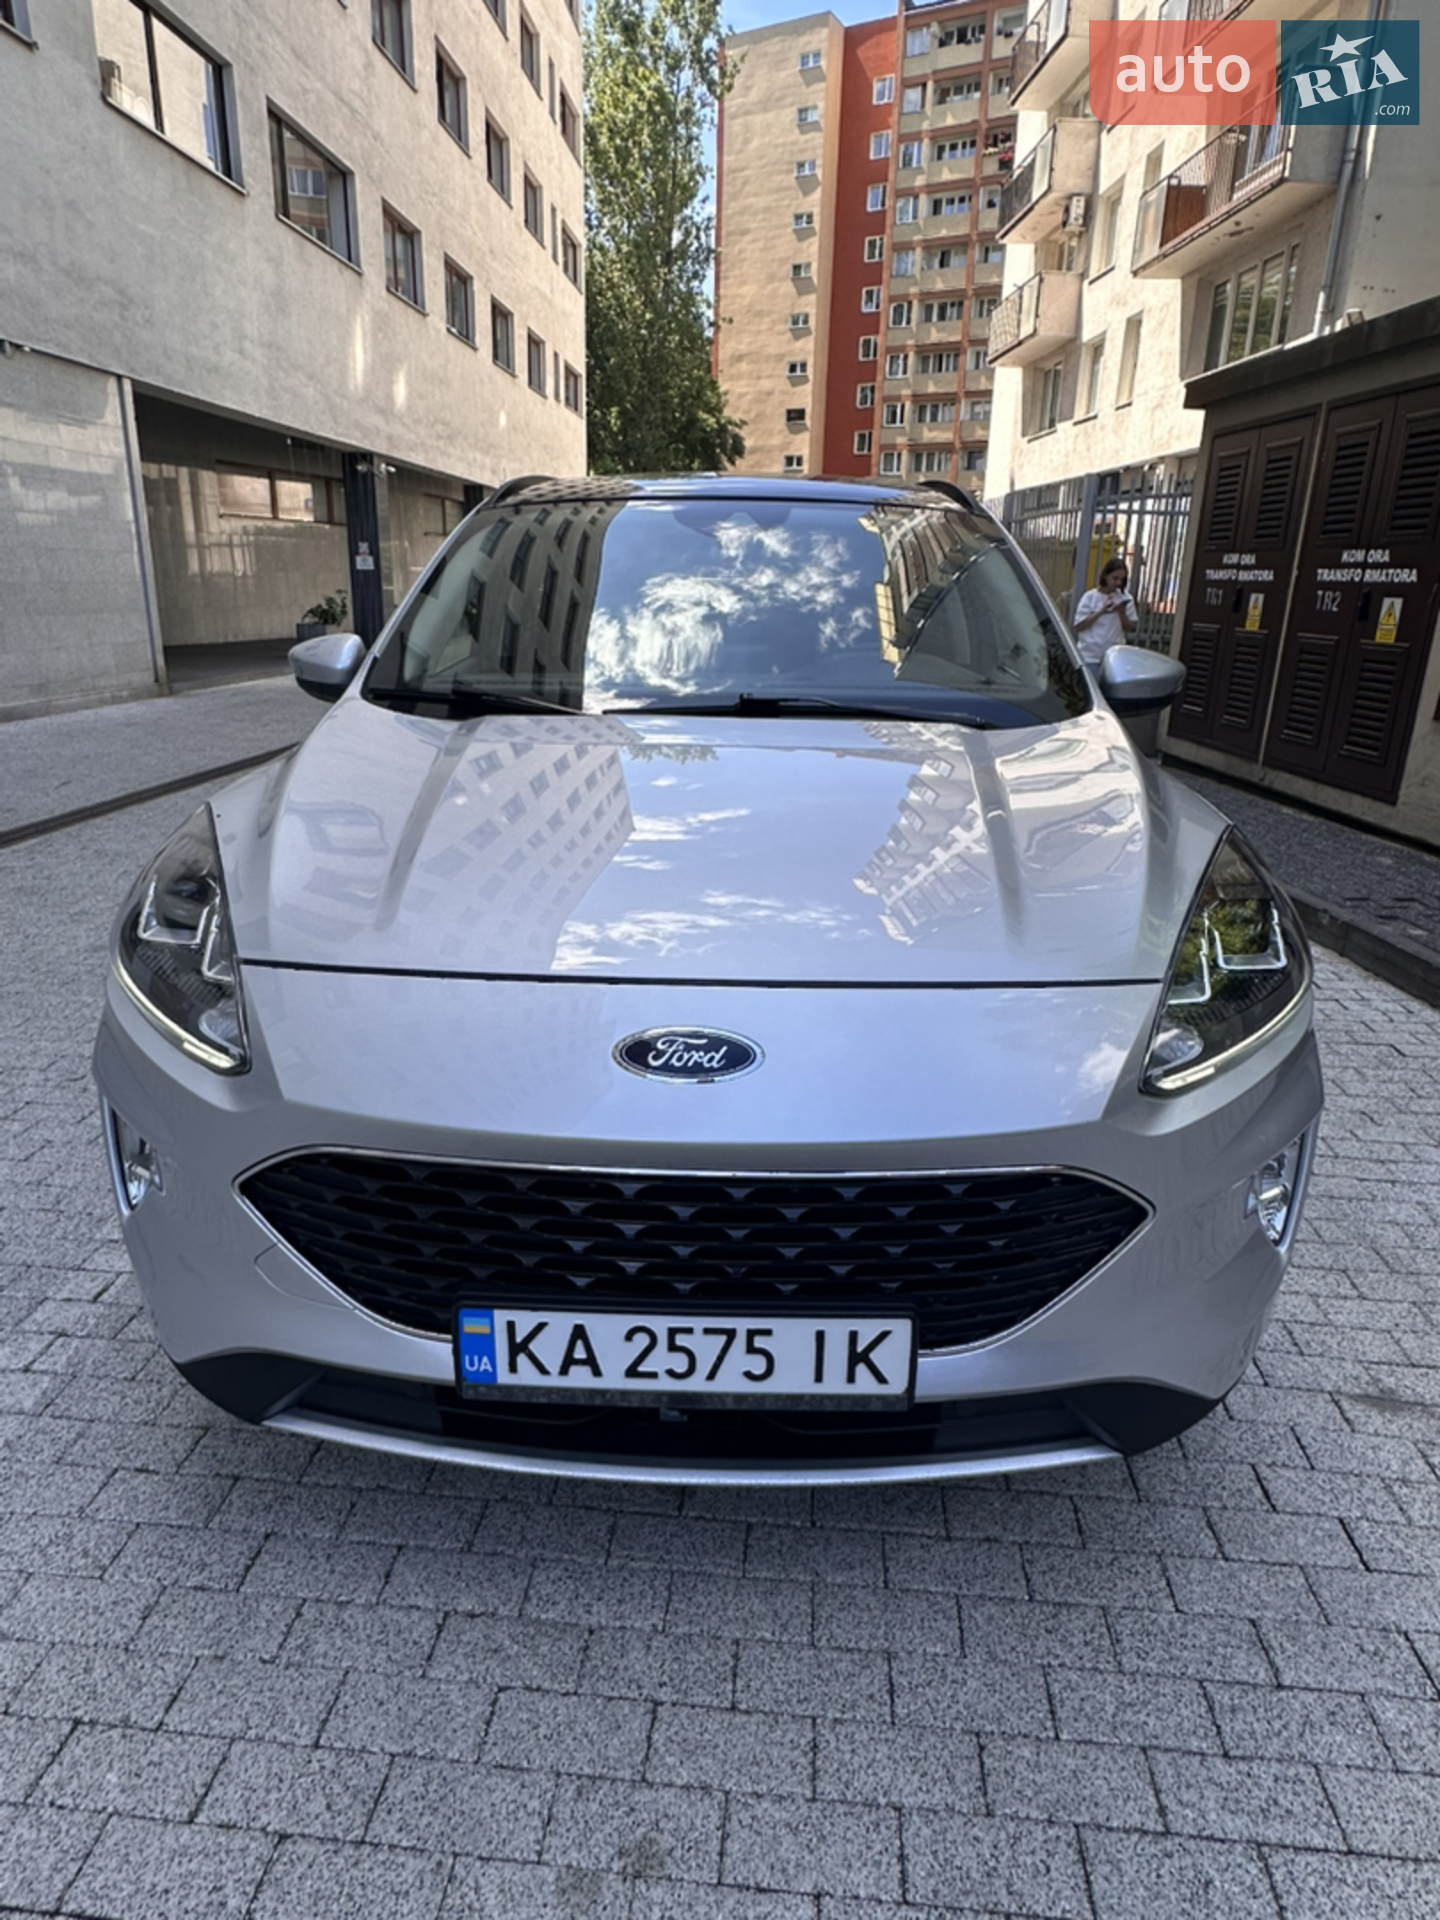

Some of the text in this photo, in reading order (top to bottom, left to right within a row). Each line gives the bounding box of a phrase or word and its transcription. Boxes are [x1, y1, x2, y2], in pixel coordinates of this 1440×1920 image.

[1316, 590, 1342, 612] TR2
[647, 1036, 728, 1068] Ford
[464, 1354, 494, 1374] UA
[505, 1319, 894, 1385] KA 2575 IK
